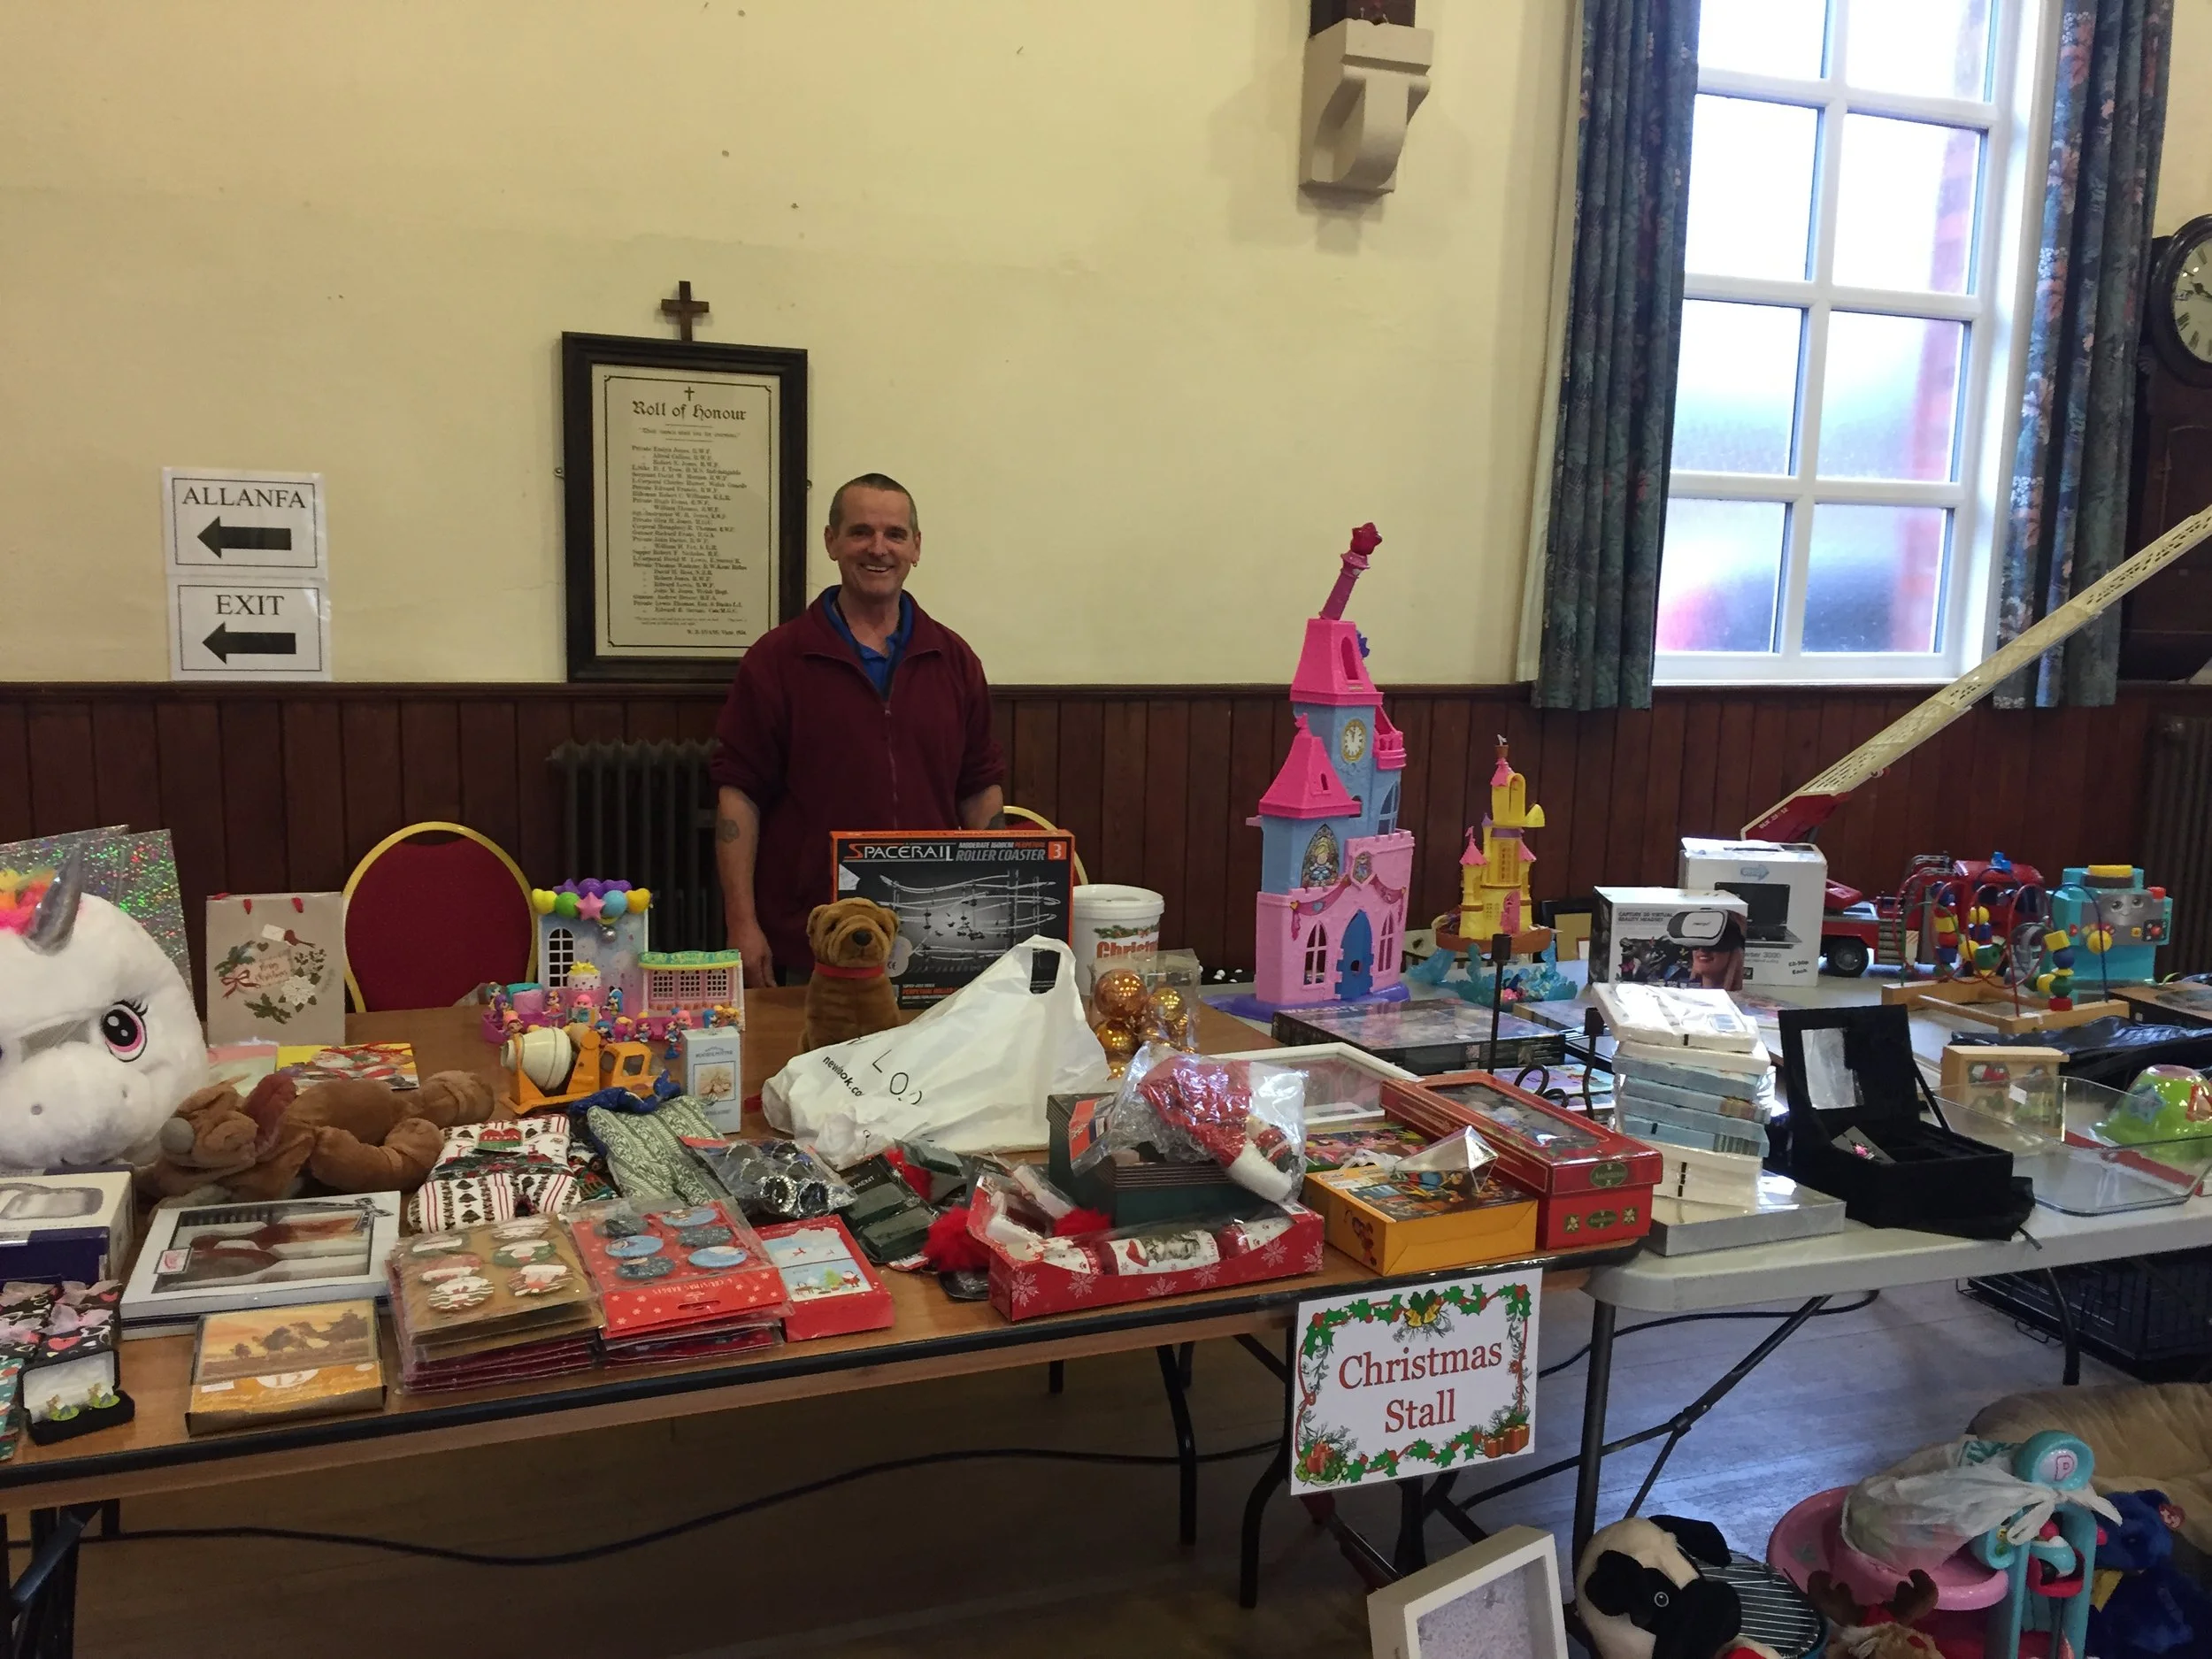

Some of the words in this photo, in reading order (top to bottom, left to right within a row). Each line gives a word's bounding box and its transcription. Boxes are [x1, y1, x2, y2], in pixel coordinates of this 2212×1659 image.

[632, 401, 666, 416] Roll
[672, 403, 687, 419] of
[693, 404, 747, 421] Honour
[182, 487, 306, 509] ALLANFA
[216, 595, 284, 616] EXIT
[844, 842, 953, 862] SPACERAIL
[956, 849, 996, 862] ROLLER
[998, 849, 1046, 861] COASTER
[1051, 844, 1062, 858] 3
[1339, 1342, 1502, 1389] Christmas
[1385, 1388, 1455, 1433] Stall
